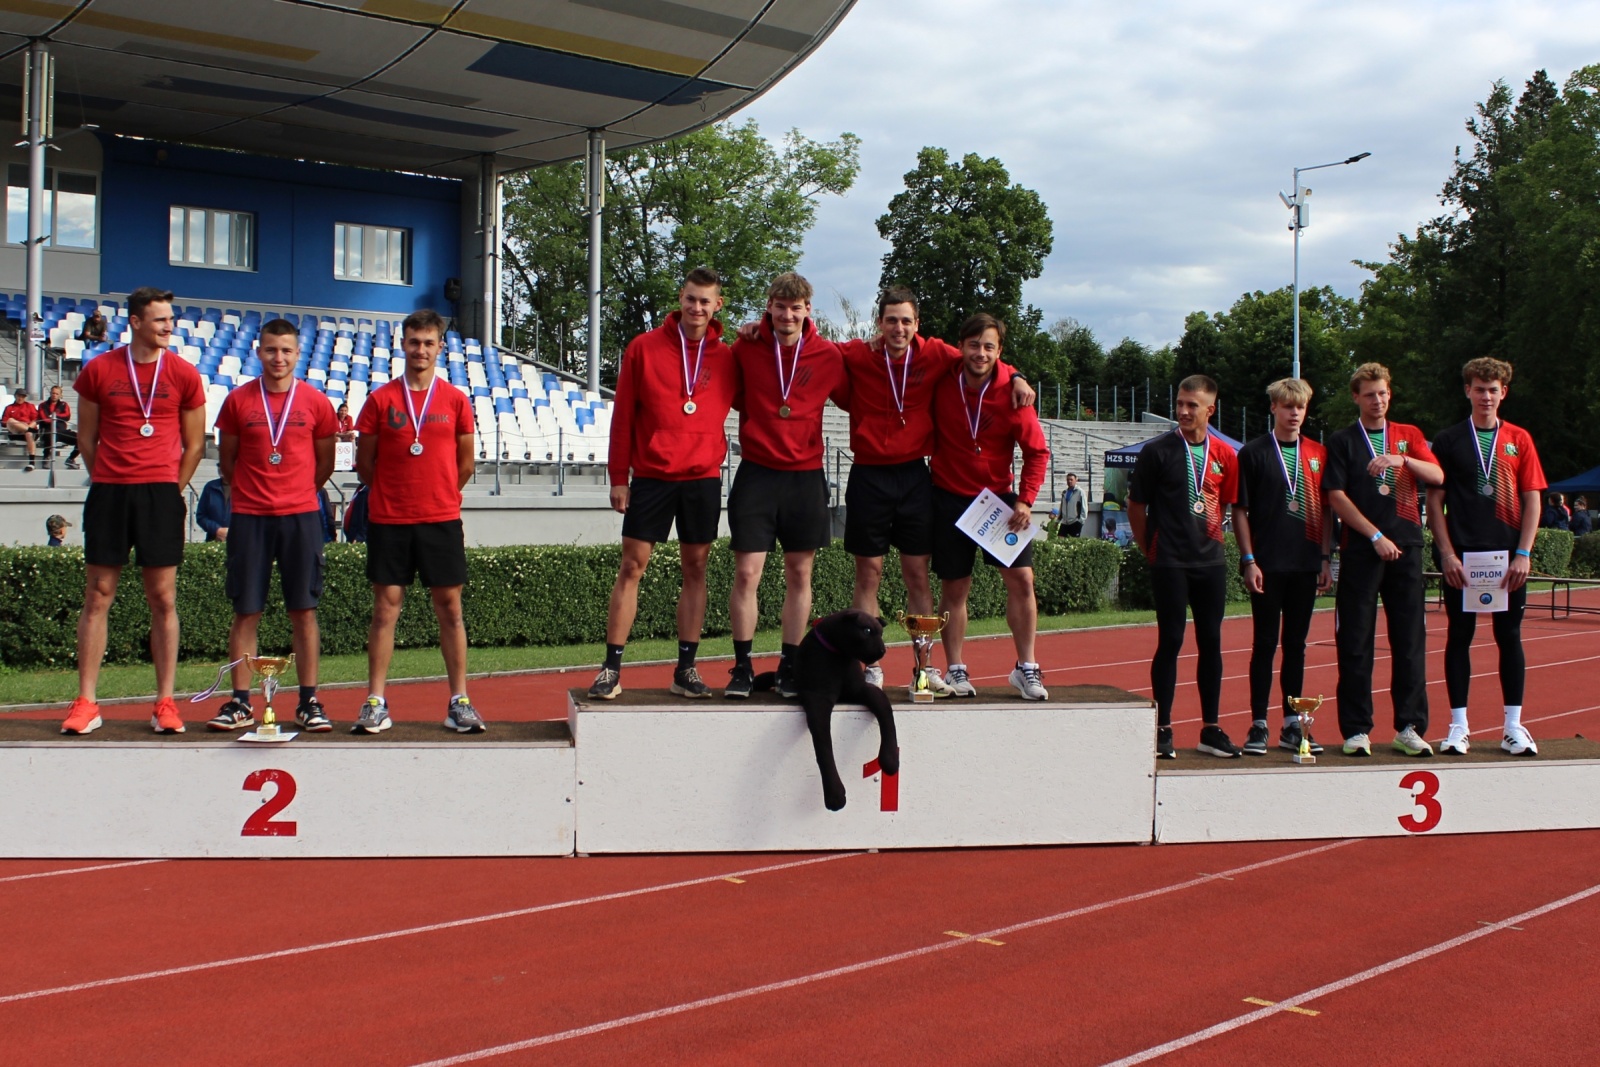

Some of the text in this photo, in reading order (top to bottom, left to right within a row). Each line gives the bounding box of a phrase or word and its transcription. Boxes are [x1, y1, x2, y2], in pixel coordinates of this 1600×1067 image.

[1106, 454, 1123, 463] HZS
[977, 507, 1003, 537] DIPLOM
[241, 769, 297, 836] 2
[863, 747, 899, 812] 1
[1398, 771, 1442, 833] 3
